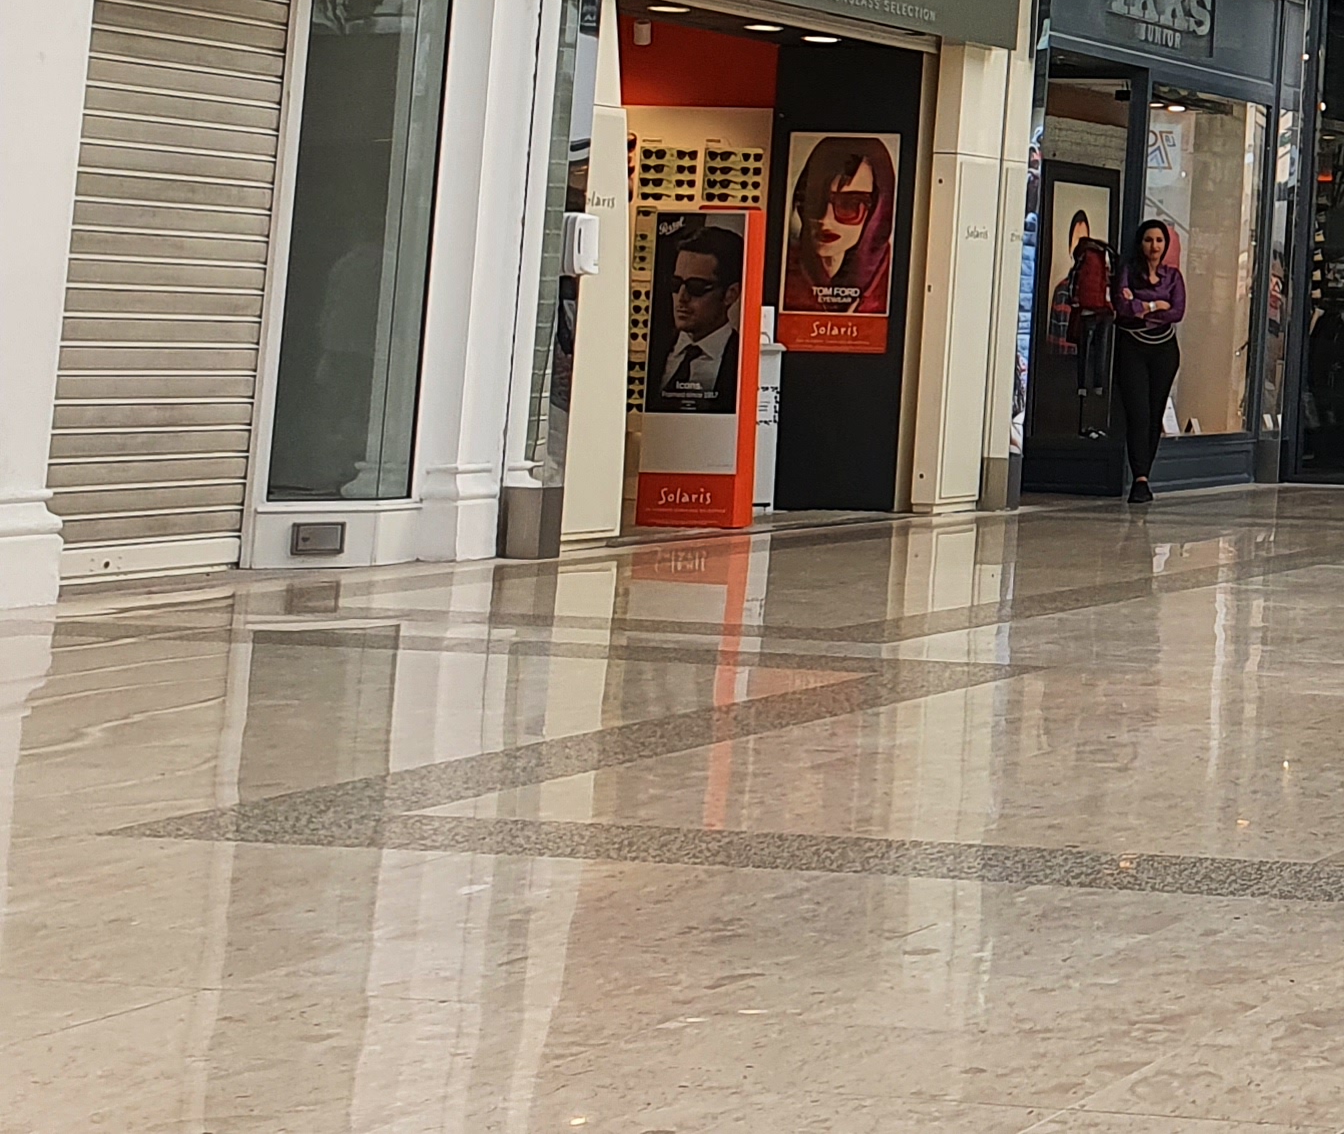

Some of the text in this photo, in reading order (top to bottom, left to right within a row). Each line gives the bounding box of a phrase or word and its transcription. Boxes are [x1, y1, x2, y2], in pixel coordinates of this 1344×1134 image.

[884, 0, 937, 22] SELECTION
[1138, 22, 1182, 49] JUNIOR
[586, 191, 616, 209] laris
[812, 287, 861, 297] TOM FORD
[810, 321, 858, 337] Solaris
[657, 488, 712, 504] Solaris
